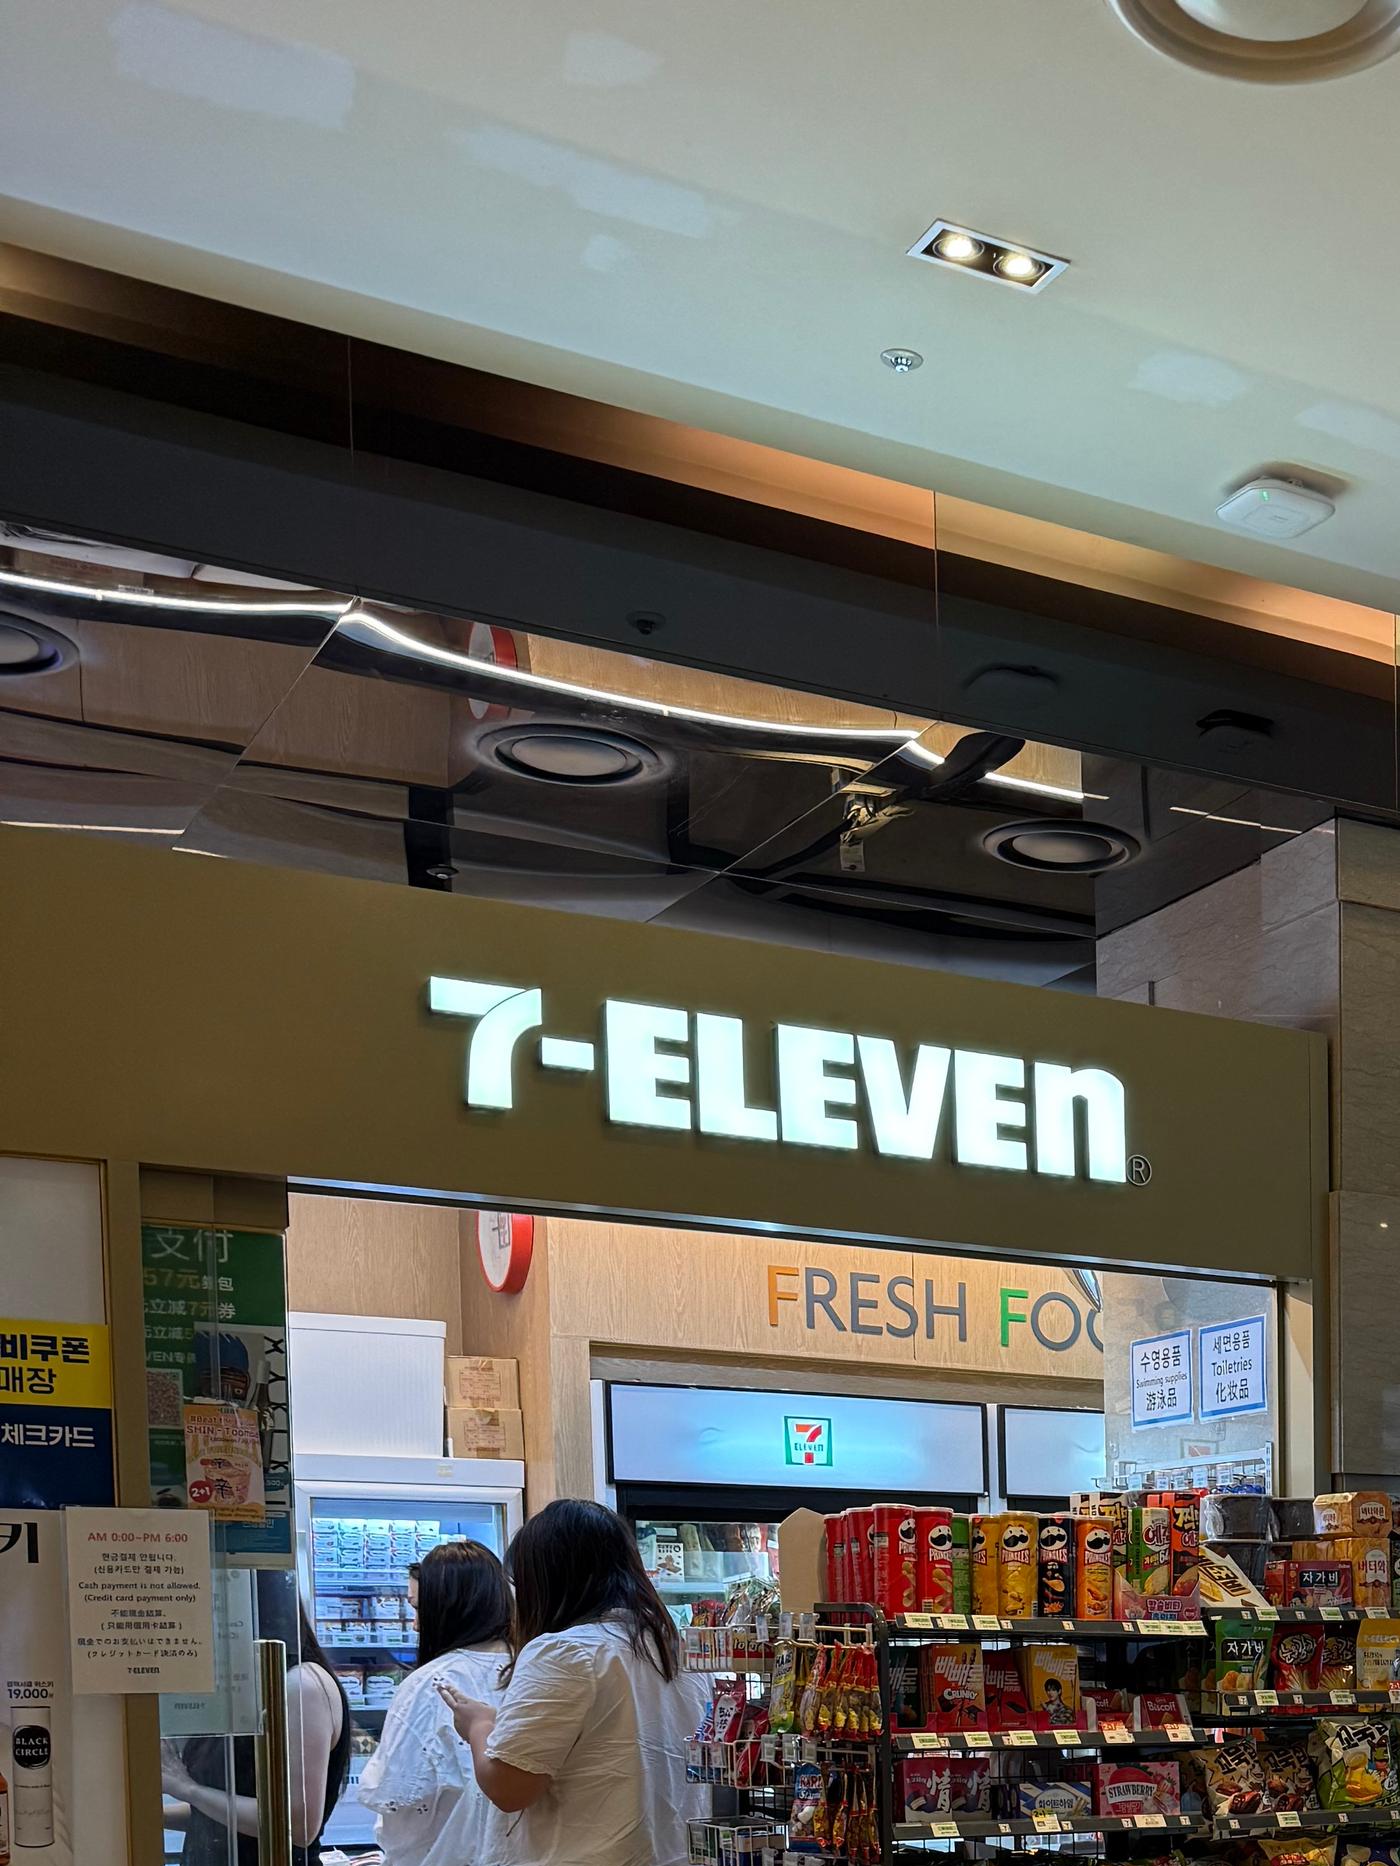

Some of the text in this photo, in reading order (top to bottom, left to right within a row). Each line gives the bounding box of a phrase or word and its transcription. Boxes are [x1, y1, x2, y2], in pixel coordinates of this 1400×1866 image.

[766, 1264, 967, 1343] FRESH
[1140, 1345, 1182, 1374] 수영용품
[1210, 1356, 1253, 1377] Toiletries
[1135, 1371, 1188, 1389] Swimming supplies
[1145, 1387, 1178, 1412] 游泳品
[1215, 1378, 1250, 1404] 化妆品
[1, 1422, 96, 1448] 체크카드
[88, 1532, 107, 1542] AM
[165, 1533, 188, 1542] 6:00
[78, 1581, 99, 1590] Cash
[101, 1582, 138, 1592] payment
[150, 1582, 164, 1590] not
[166, 1581, 201, 1590] allowed.
[1302, 1571, 1339, 1585] 자가비
[84, 1594, 197, 1604] (Credit card payment only)
[942, 1688, 978, 1700] CRUNKY
[15, 1736, 49, 1746] BLACK
[15, 1747, 49, 1757] CIRCLE
[1107, 1783, 1156, 1800] STRAWBERRY
